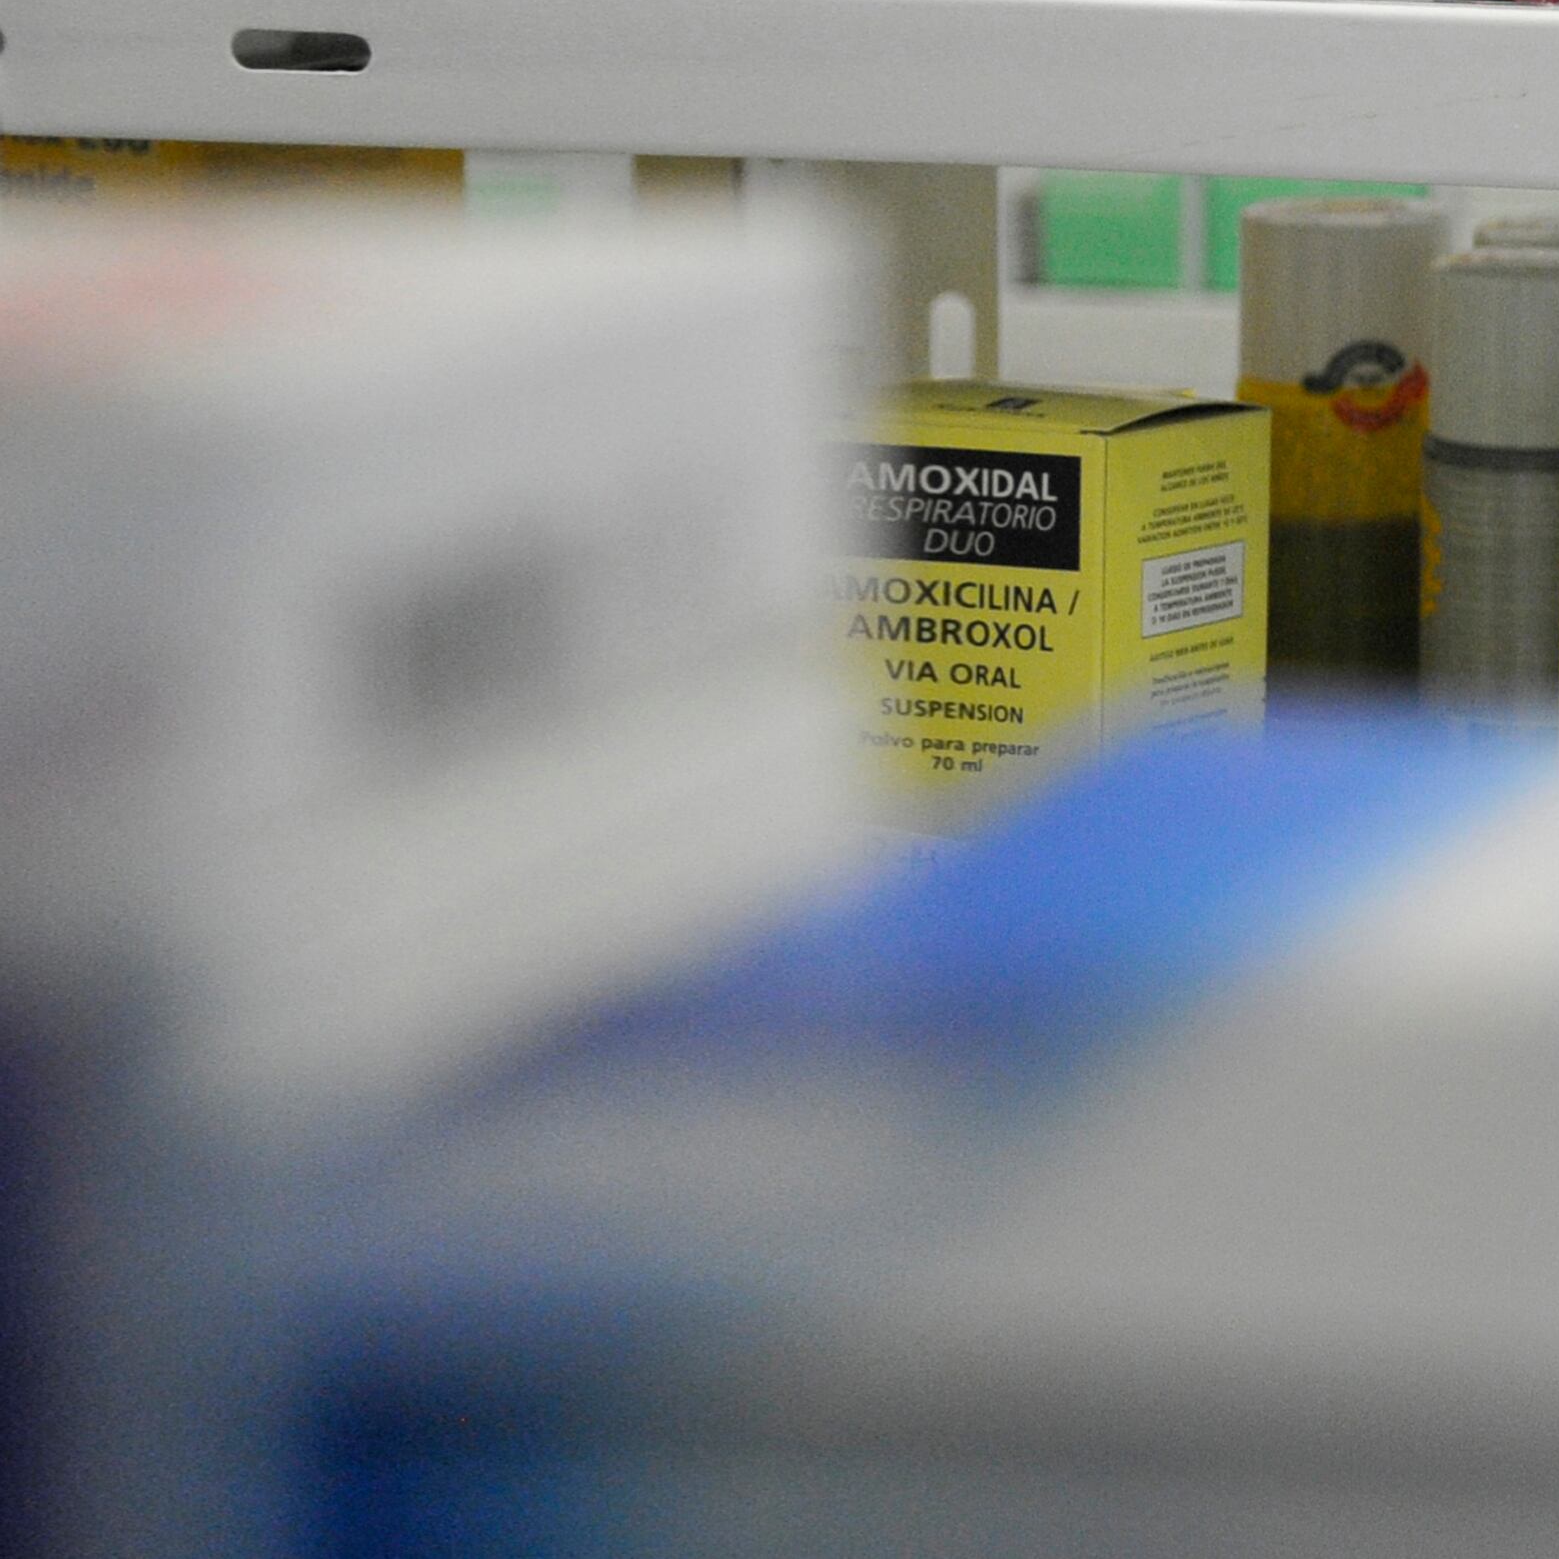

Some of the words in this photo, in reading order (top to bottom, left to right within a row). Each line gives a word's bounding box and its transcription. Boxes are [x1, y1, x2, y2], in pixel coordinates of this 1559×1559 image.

[847, 461, 1058, 502] AMOXIDAL
[924, 529, 995, 557] DUO
[847, 613, 1054, 652] AMBROXOL
[884, 659, 938, 683] VIA
[949, 662, 1022, 689] ORAL
[881, 698, 1024, 724] SUSPENSION
[921, 735, 965, 756] para
[972, 740, 1040, 758] preparar
[932, 756, 954, 771] 70
[961, 758, 982, 772] ml
